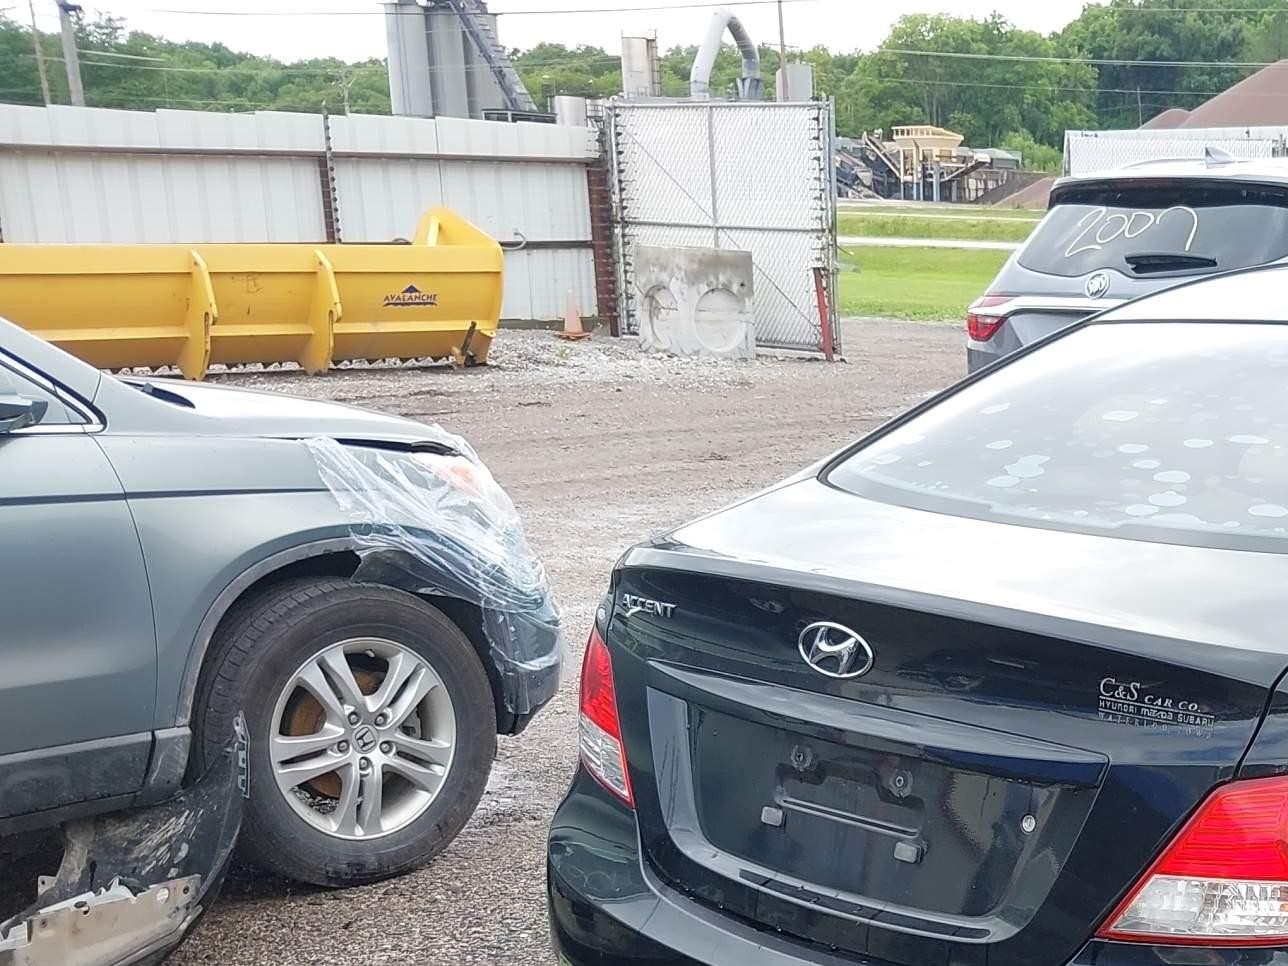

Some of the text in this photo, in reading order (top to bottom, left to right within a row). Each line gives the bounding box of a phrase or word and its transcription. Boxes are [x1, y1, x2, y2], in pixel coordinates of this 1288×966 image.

[1065, 206, 1198, 257] 2007
[383, 293, 437, 302] AVALANCHE
[622, 593, 677, 618] ACCENT
[1099, 677, 1201, 713] C&S CAR CO.
[1099, 699, 1138, 714] HYUNDAI
[1177, 713, 1215, 728] SUBARU
